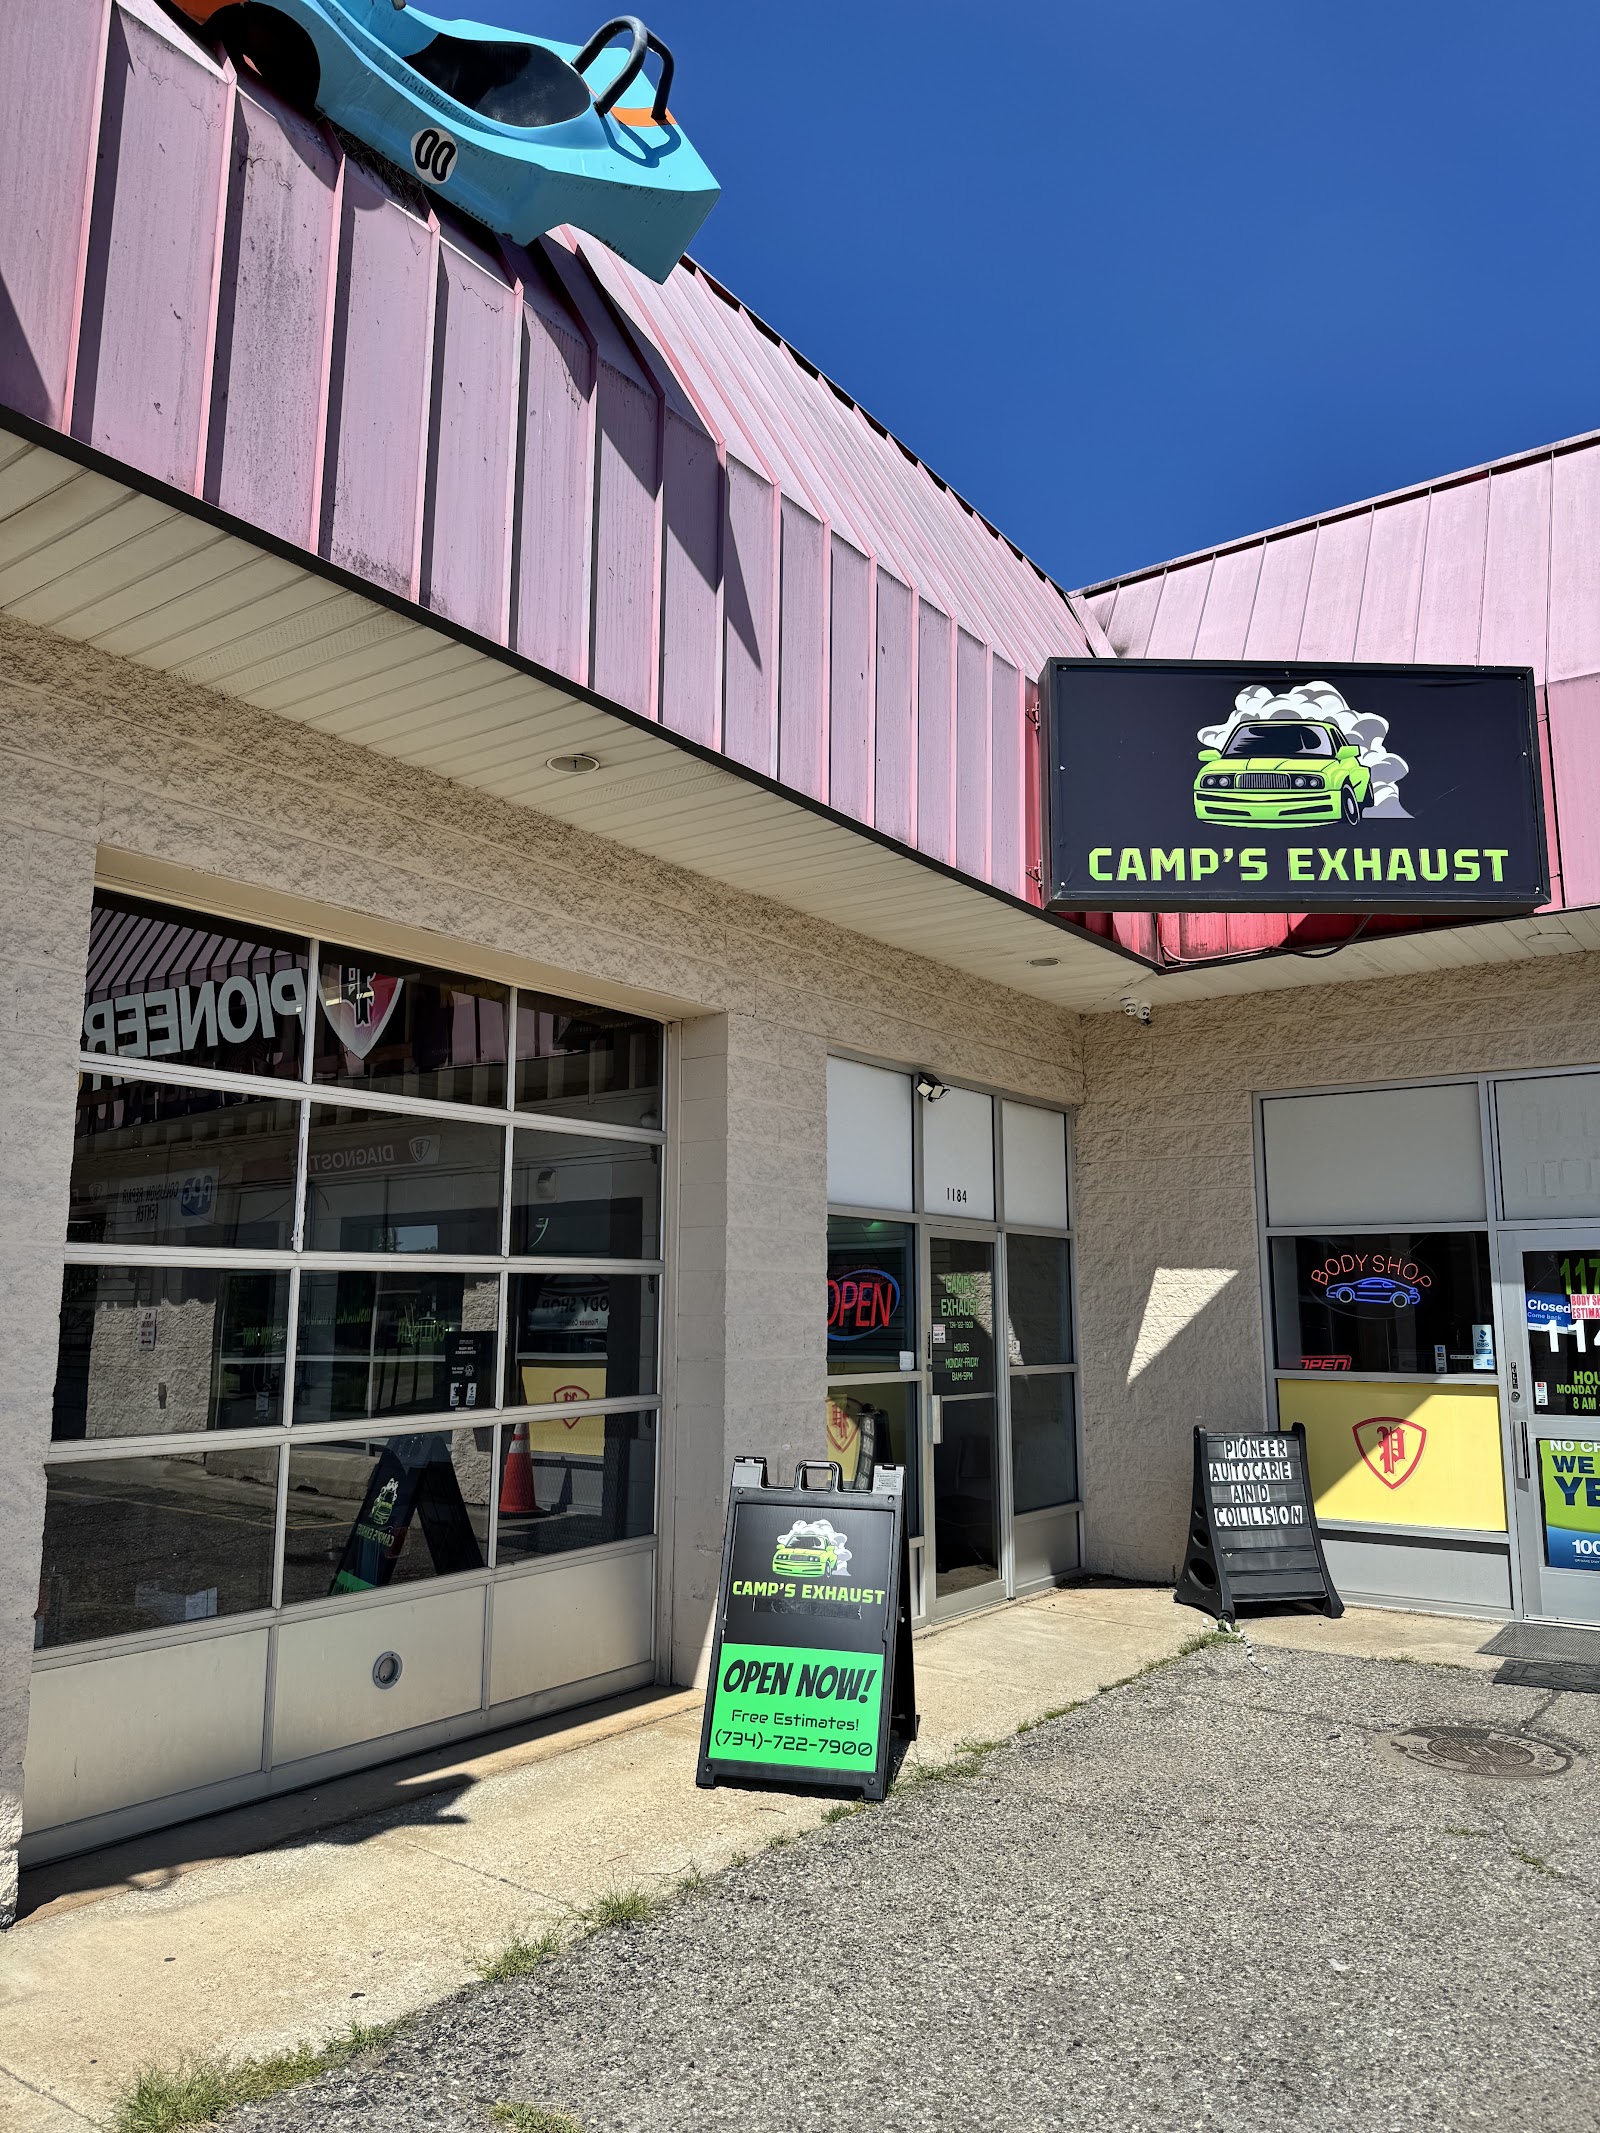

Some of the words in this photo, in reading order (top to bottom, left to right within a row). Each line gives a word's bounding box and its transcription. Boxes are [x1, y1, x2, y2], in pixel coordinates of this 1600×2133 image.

[1088, 847, 1268, 882] CAMP'S
[1287, 847, 1509, 883] EXHAUST
[947, 1187, 967, 1203] 1184
[1311, 1254, 1368, 1286] BODY
[1372, 1254, 1432, 1288] SHOP
[940, 1299, 978, 1317] EXHAUST
[1527, 1299, 1571, 1314] Closed
[1571, 1295, 1590, 1306] BODY
[1572, 1308, 1600, 1319] ESTIMA
[953, 1343, 970, 1352] HOURS
[1556, 1384, 1598, 1395] MONDAY
[1573, 1397, 1579, 1410] 8
[1581, 1397, 1597, 1410] AM
[1225, 1440, 1286, 1458] PIONEER
[1550, 1440, 1575, 1452] NO
[1212, 1462, 1290, 1481] AUTOCARE
[1551, 1455, 1595, 1474] WE
[1233, 1486, 1269, 1502] AND
[1216, 1506, 1301, 1526] COLLISION
[732, 1580, 796, 1598] CAMP'S
[801, 1584, 886, 1605] EXHAUST
[723, 1659, 794, 1696] OPEN
[795, 1664, 878, 1704] NOW!
[731, 1709, 769, 1724] Free
[773, 1712, 860, 1731] Estimates!
[715, 1728, 874, 1757] (734)-722-7900
